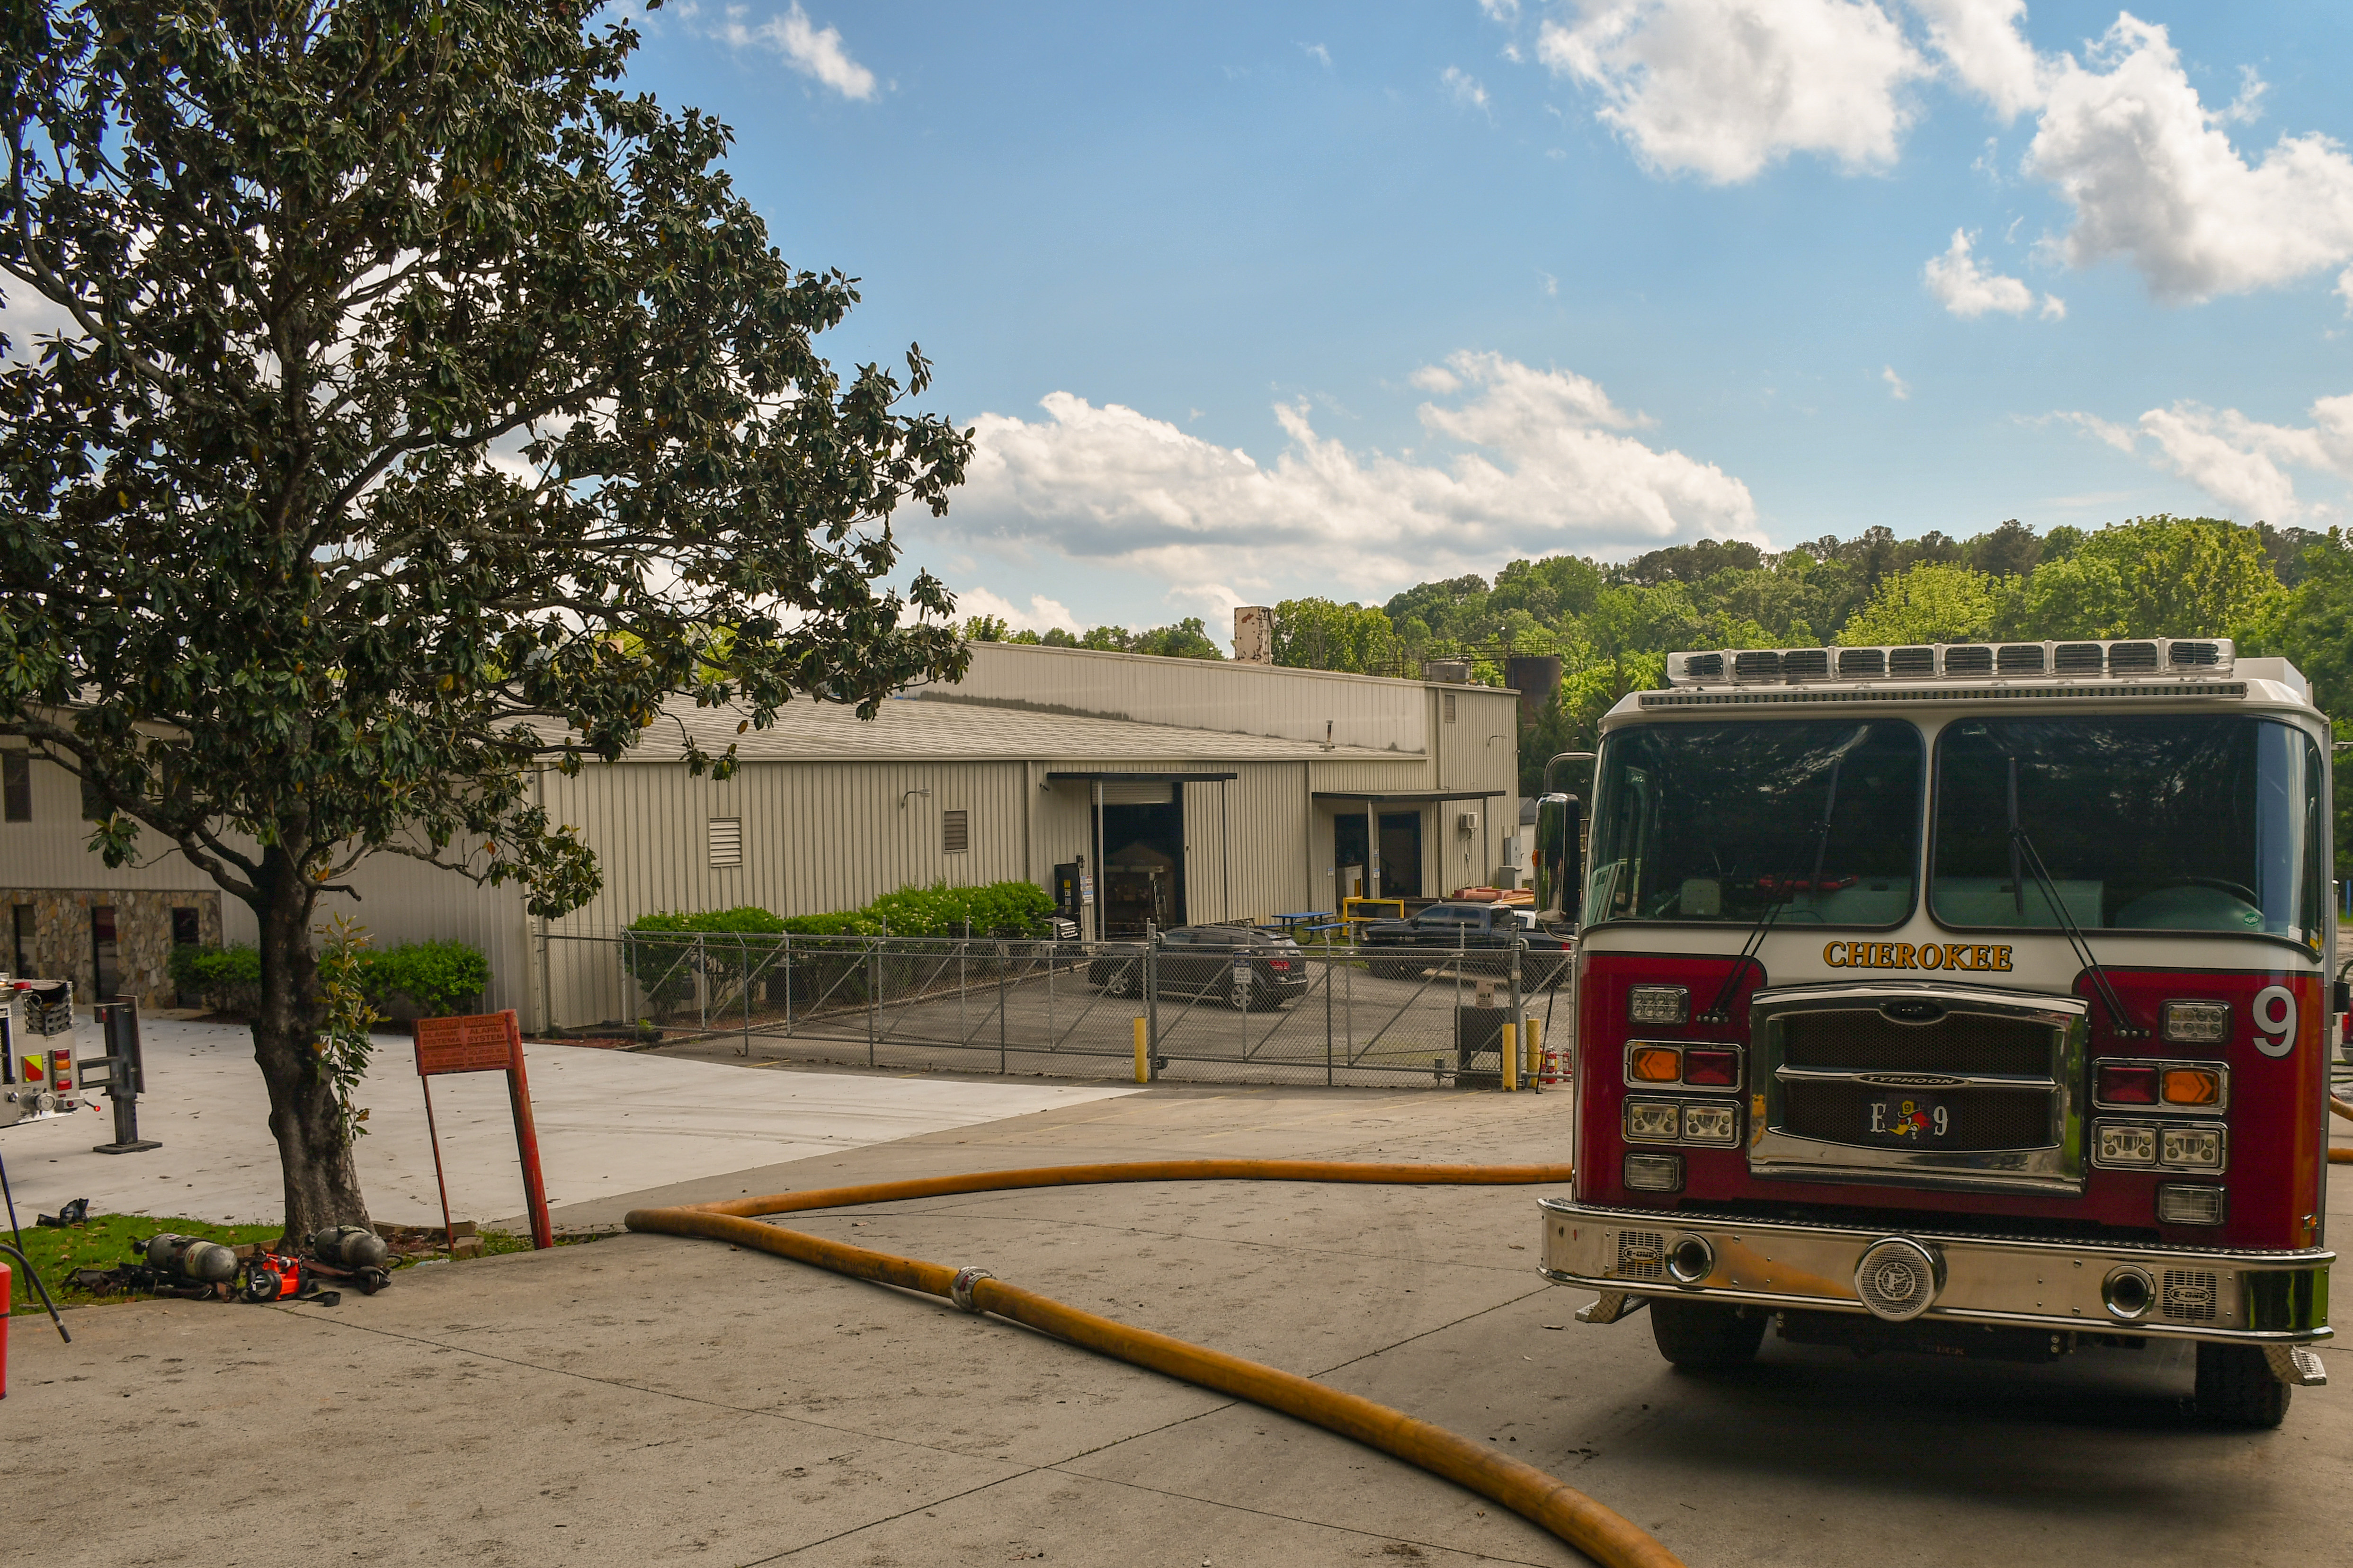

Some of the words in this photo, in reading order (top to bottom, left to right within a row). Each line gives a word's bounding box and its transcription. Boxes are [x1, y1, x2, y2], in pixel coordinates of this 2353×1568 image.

[1823, 941, 2013, 972] CHEROKEE
[465, 1017, 503, 1027] WARNING
[2252, 985, 2297, 1059] 9
[470, 1026, 501, 1034] ALARM
[422, 1037, 461, 1045] SISTEMA
[467, 1034, 505, 1042] SYSTEM
[1867, 1076, 1956, 1084] TYPHOON
[1904, 1104, 1912, 1112] 9
[1870, 1103, 1886, 1133] E
[1933, 1106, 1948, 1136] 9
